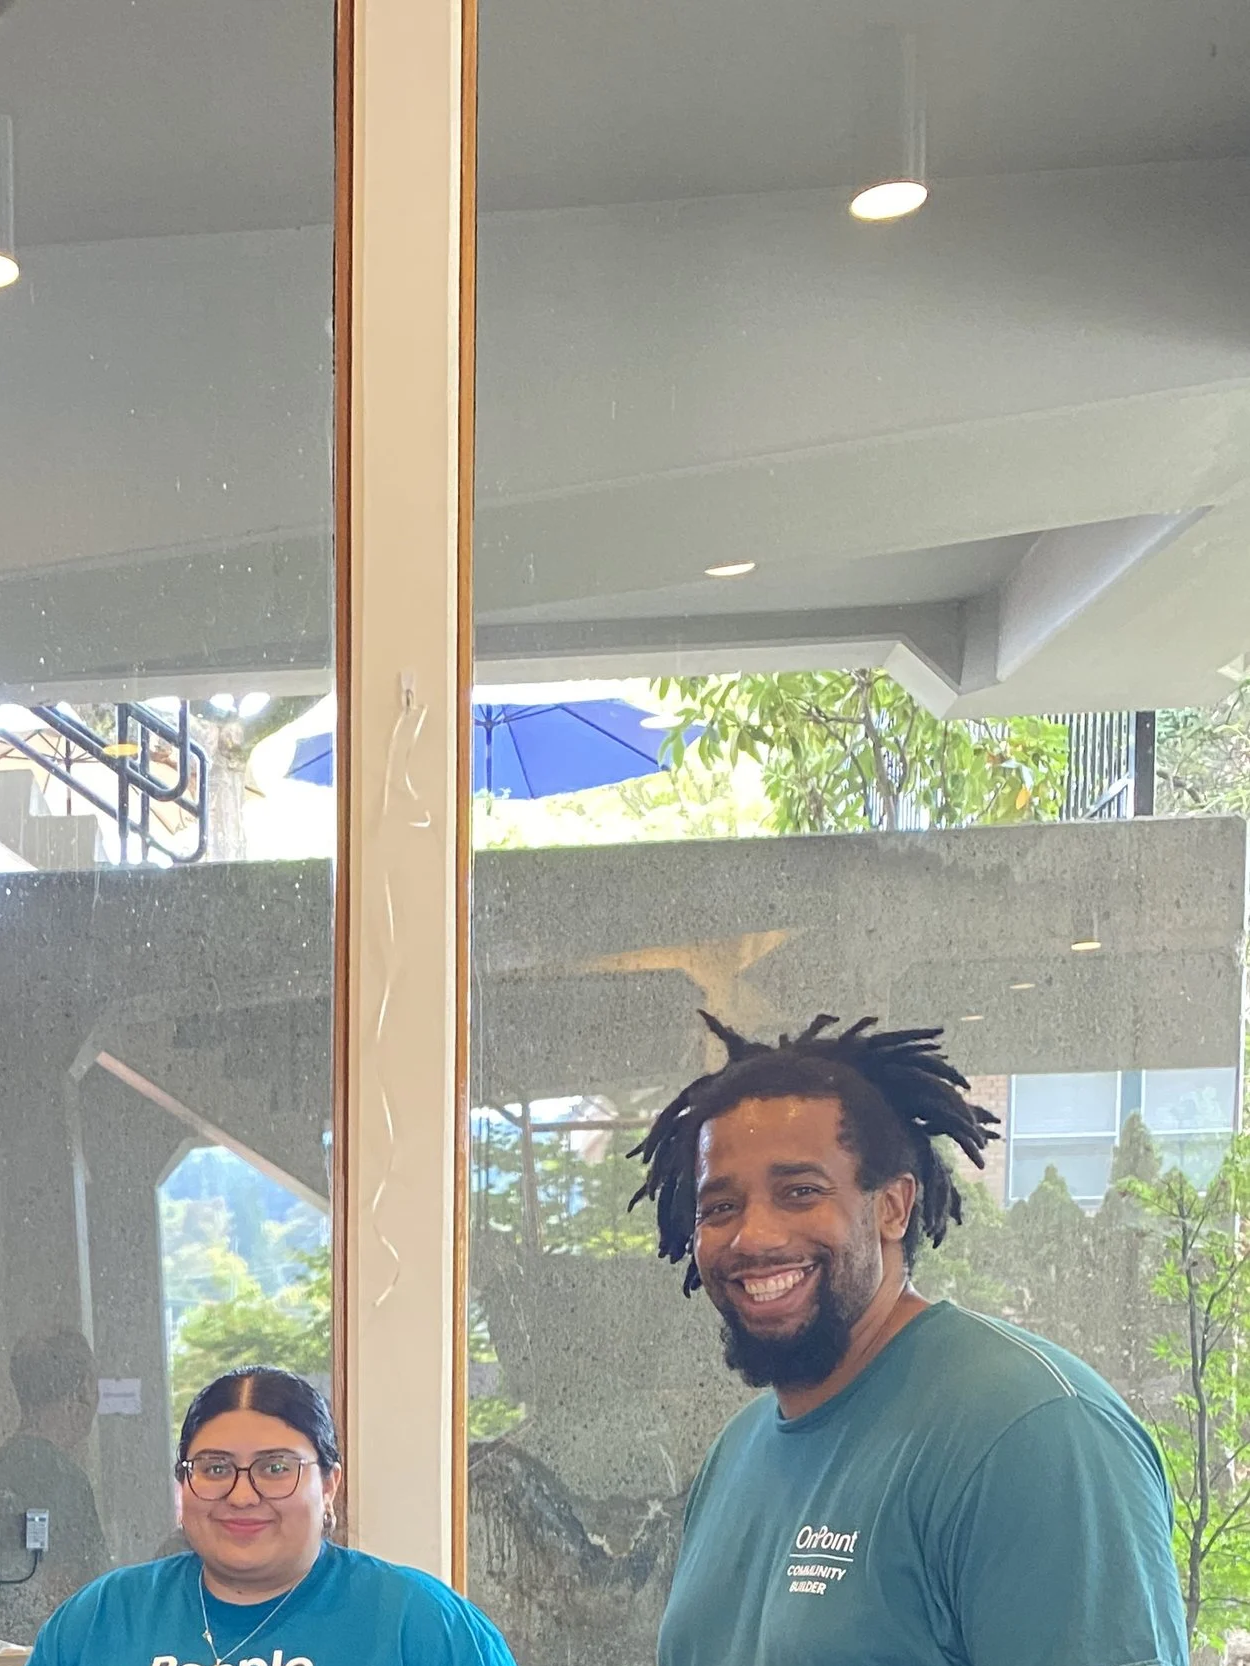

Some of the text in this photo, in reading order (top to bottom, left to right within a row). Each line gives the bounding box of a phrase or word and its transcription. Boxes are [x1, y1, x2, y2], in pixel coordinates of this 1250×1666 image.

[796, 1525, 858, 1553] OnPoint
[787, 1564, 846, 1580] COMMUNITY
[789, 1581, 827, 1595] BUILDER
